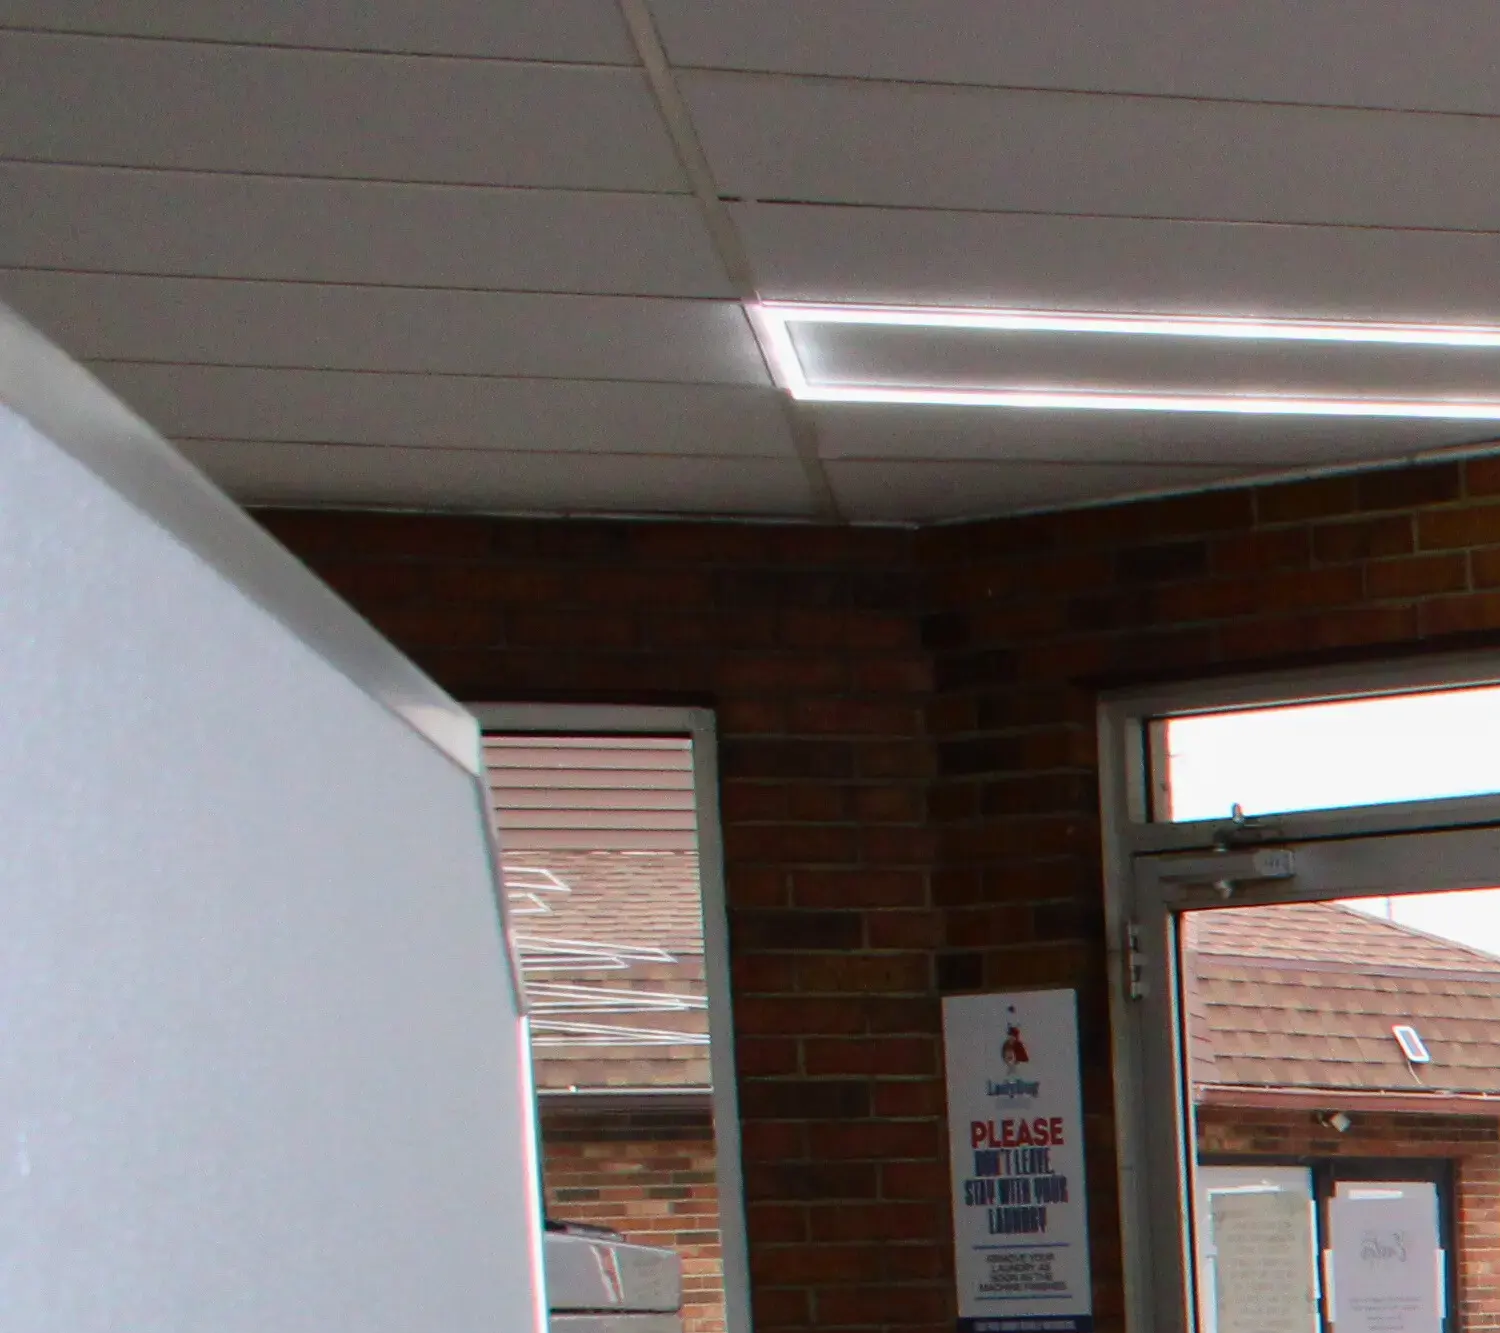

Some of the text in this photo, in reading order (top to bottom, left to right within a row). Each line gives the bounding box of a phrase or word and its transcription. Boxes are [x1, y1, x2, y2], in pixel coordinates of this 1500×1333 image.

[970, 1117, 1065, 1148] PLEASE
[964, 1175, 1069, 1206] STAY WITH YOUR
[988, 1206, 1047, 1234] LAUNDRY
